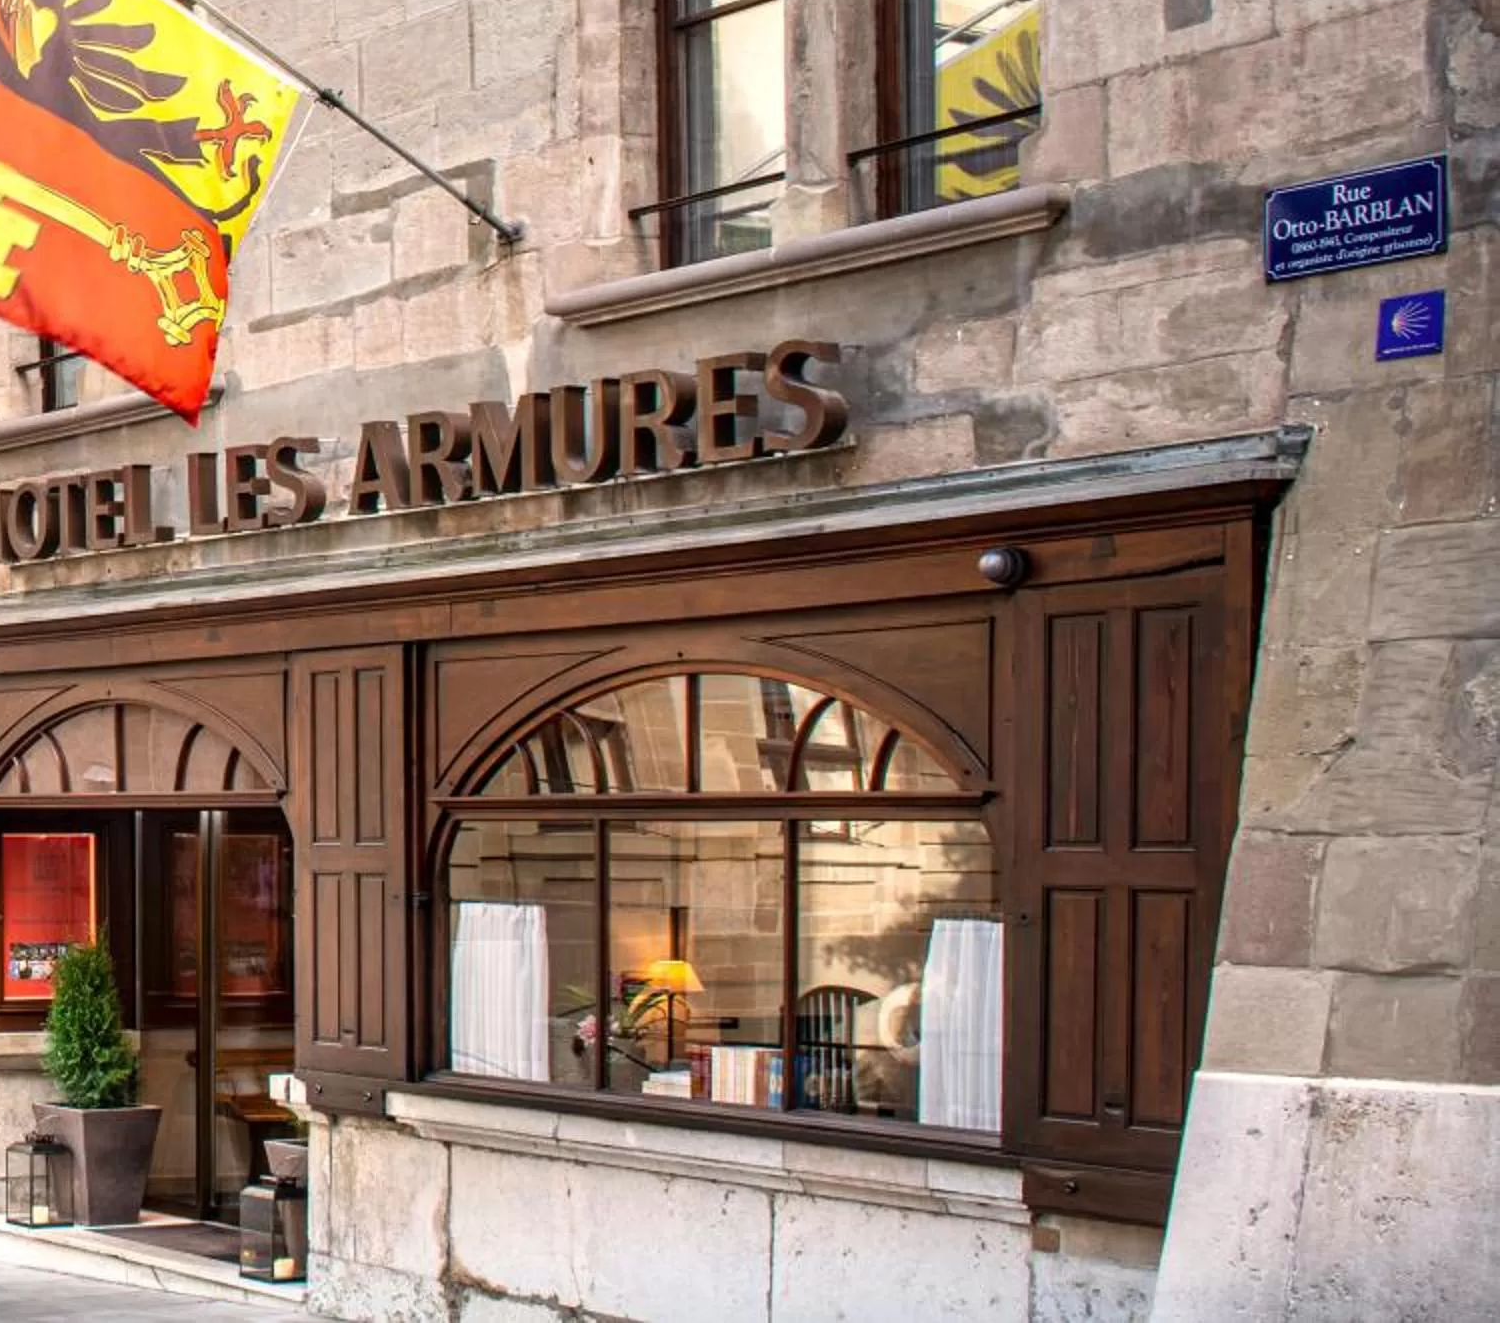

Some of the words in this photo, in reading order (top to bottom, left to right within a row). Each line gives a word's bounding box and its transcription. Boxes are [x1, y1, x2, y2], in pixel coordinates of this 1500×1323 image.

[1273, 190, 1433, 240] Otto-BARBLAN
[1332, 184, 1371, 206] Rue
[188, 436, 326, 536] LES
[347, 339, 850, 515] ARMURES
